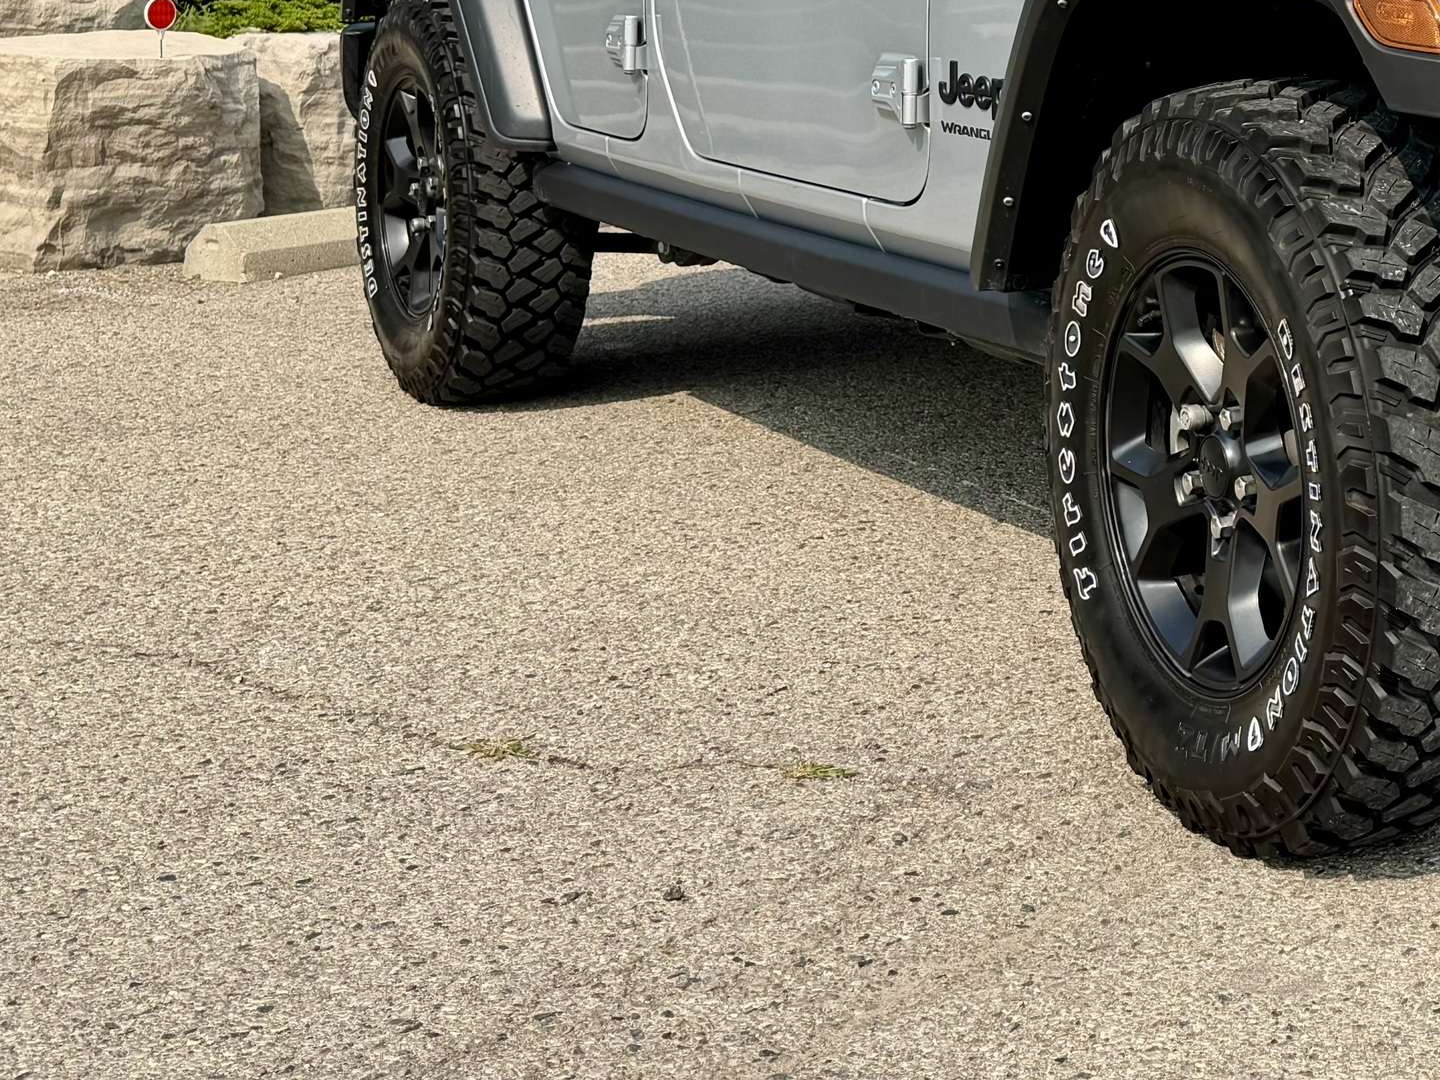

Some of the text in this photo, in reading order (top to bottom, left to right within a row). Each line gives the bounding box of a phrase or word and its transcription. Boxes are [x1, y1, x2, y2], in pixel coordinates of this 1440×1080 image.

[356, 90, 377, 298] DESTINATION
[1057, 248, 1105, 601] Firestone
[1266, 318, 1324, 733] DESTINATION
